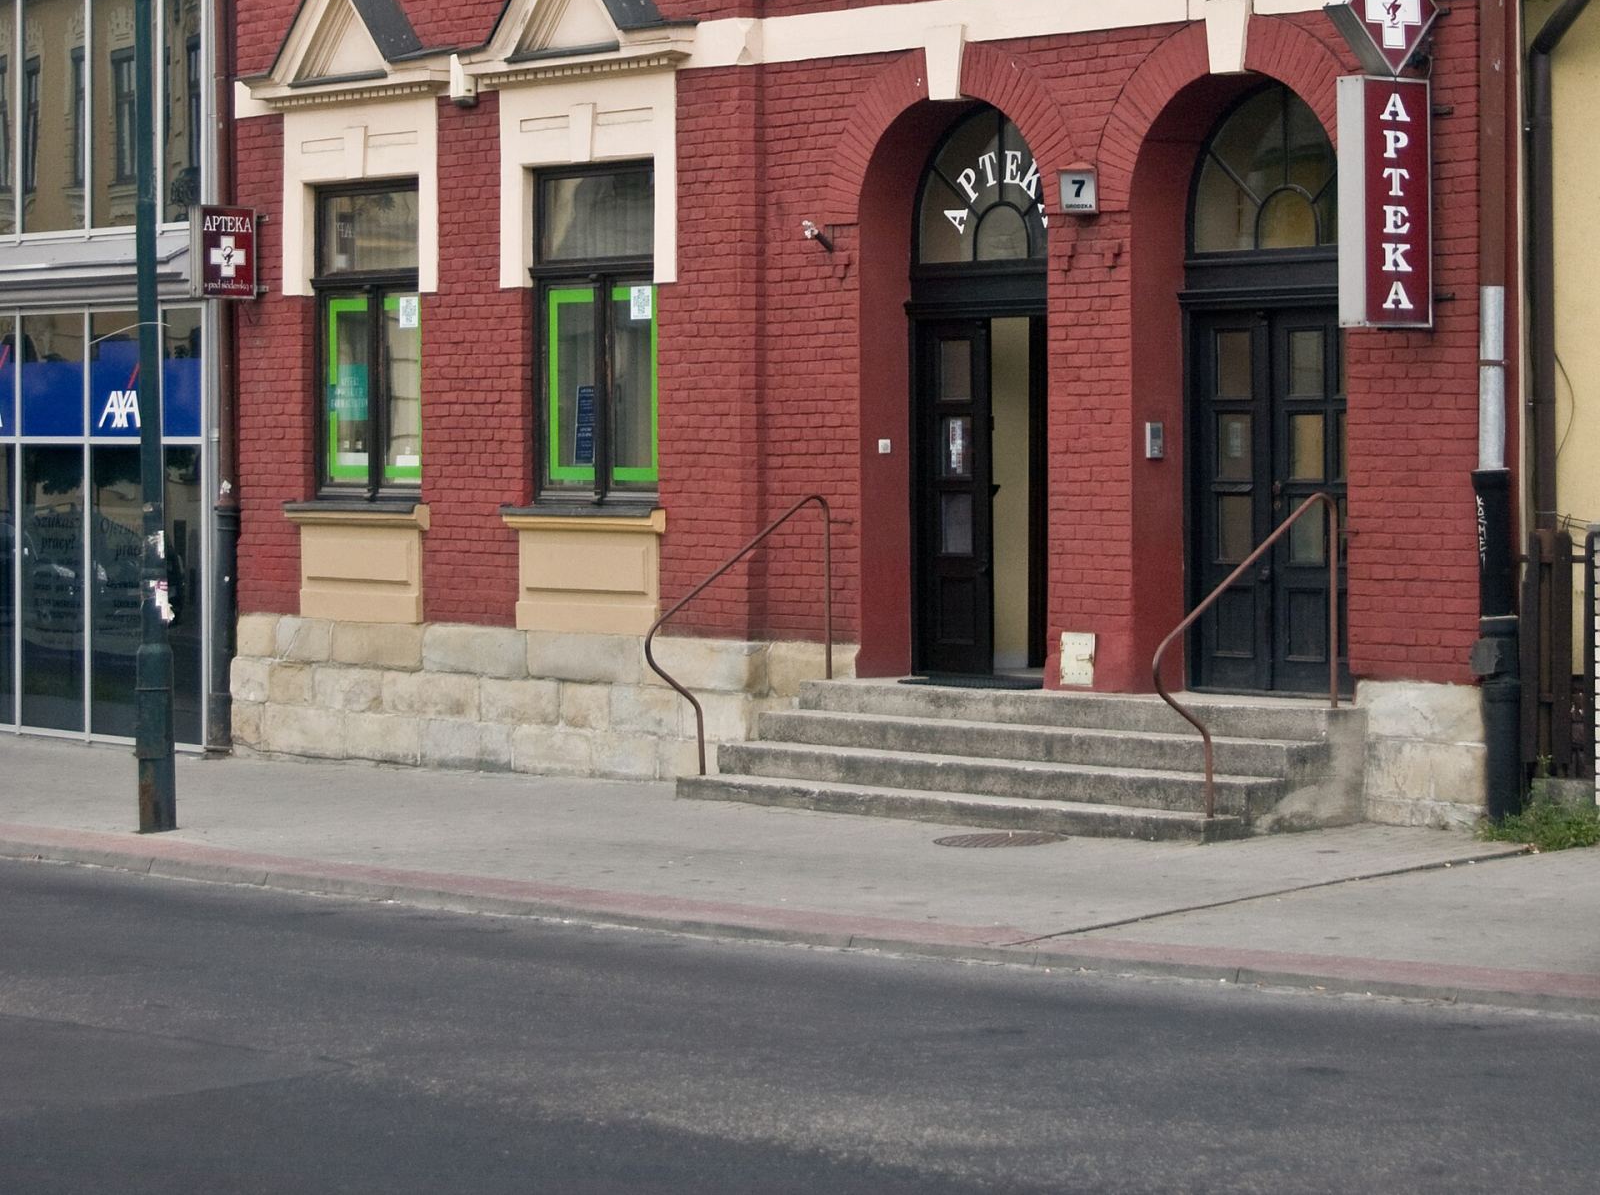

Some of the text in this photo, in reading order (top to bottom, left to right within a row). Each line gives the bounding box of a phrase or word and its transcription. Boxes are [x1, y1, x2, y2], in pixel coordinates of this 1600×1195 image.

[1071, 179, 1086, 198] 7
[1380, 93, 1413, 309] APTEKA
[203, 215, 253, 233] APTEKA
[98, 390, 141, 428] AXA
